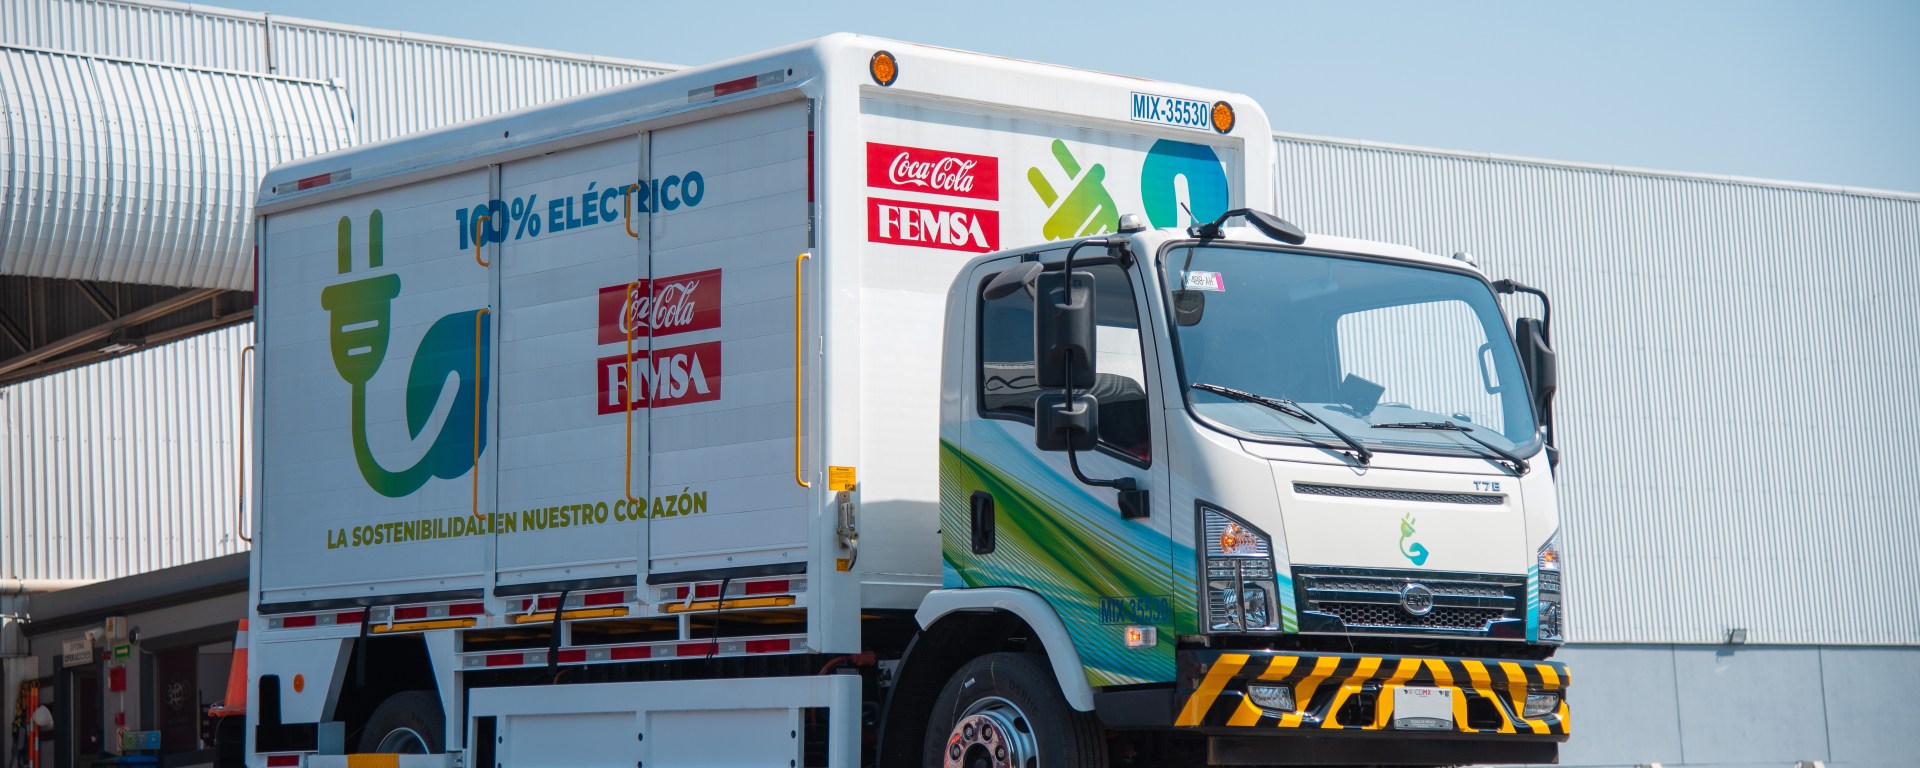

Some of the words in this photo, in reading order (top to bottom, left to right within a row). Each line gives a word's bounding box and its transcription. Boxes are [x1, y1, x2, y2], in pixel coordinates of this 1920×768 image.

[1133, 94, 1208, 127] MIX-35530
[888, 151, 978, 193] Coca-Cola
[455, 194, 541, 251] 100%
[548, 170, 705, 234] ELÉCTRICO
[877, 203, 991, 249] FEMSA
[618, 279, 700, 335] Coa-Cola
[1473, 480, 1501, 492] T7E
[327, 527, 348, 550] LA
[487, 511, 517, 536] EN
[522, 501, 609, 532] NUESTRO
[613, 486, 707, 523] CORAZÓN
[1101, 597, 1169, 624] MIX-35530
